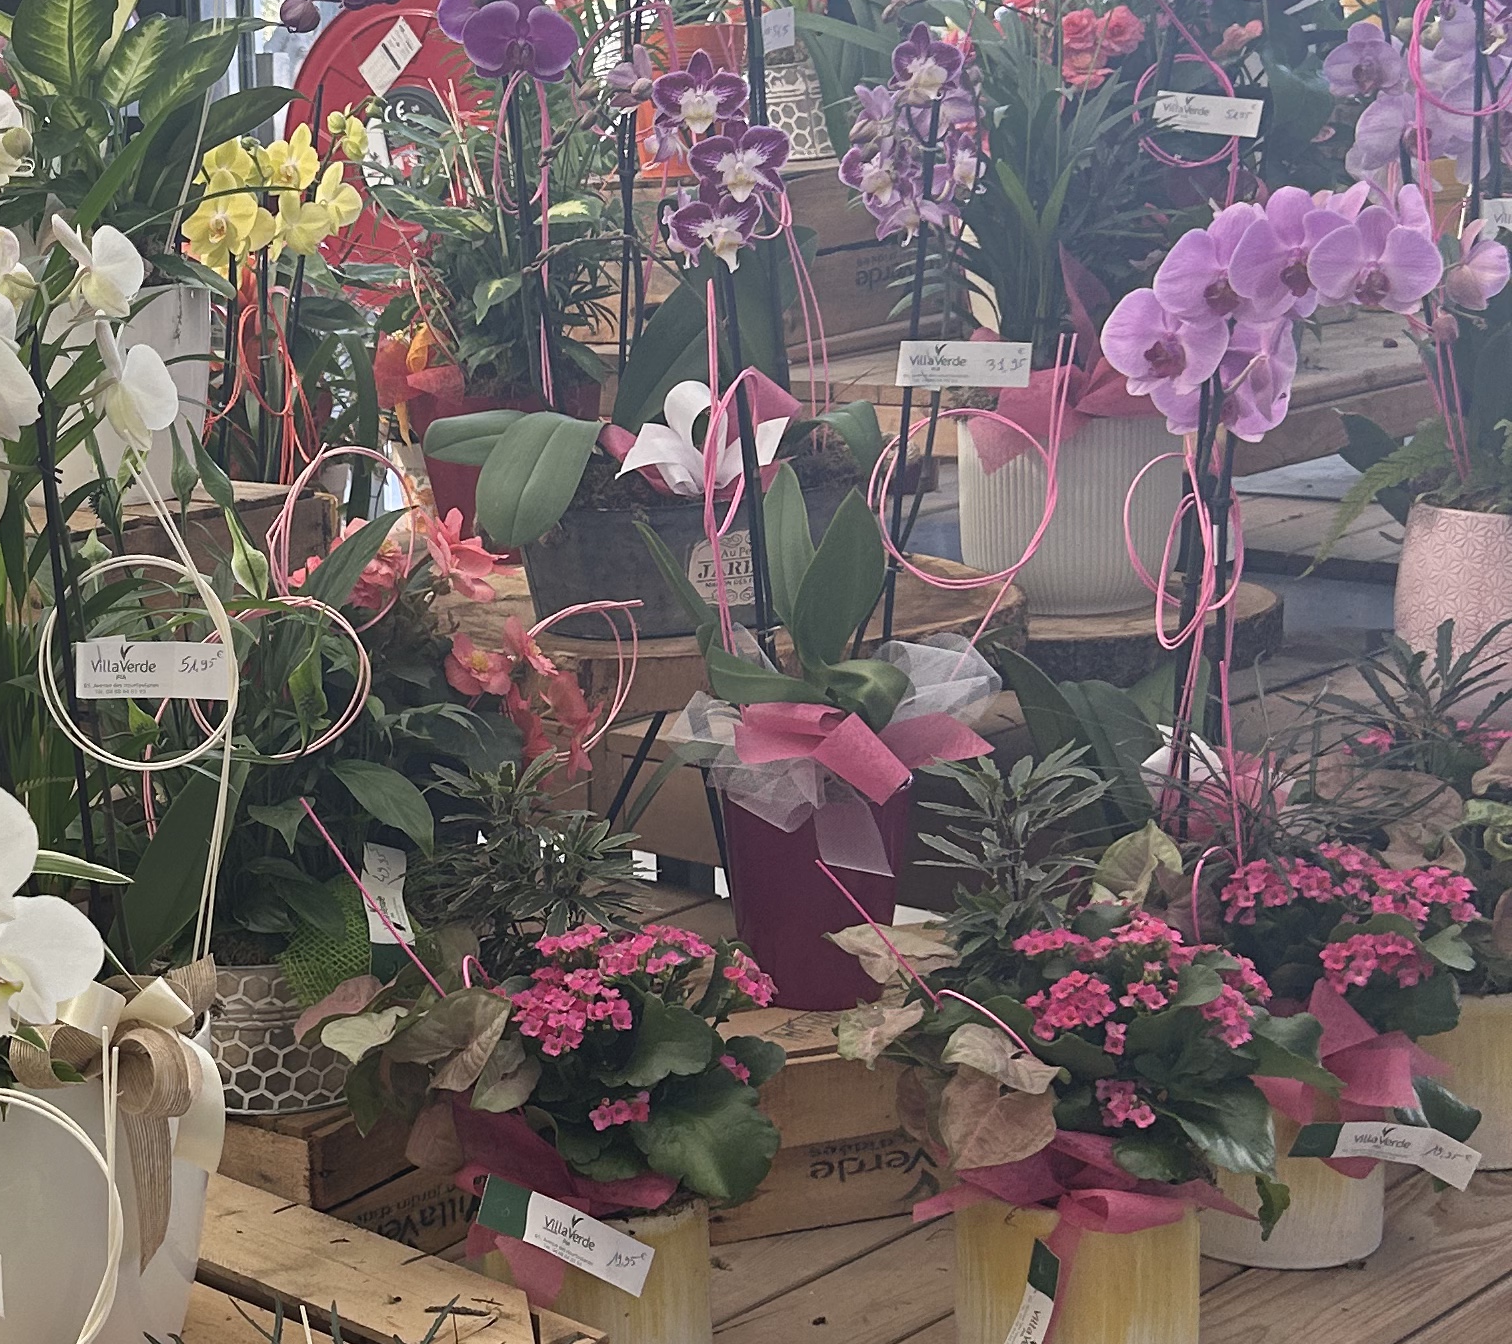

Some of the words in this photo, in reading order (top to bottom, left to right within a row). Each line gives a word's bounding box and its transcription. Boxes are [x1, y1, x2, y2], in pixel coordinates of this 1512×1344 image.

[909, 355, 967, 367] VillaVerde
[91, 658, 157, 674] VillaVerde
[1354, 1134, 1411, 1149] VillaVerde
[545, 1215, 596, 1251] VillaVerde
